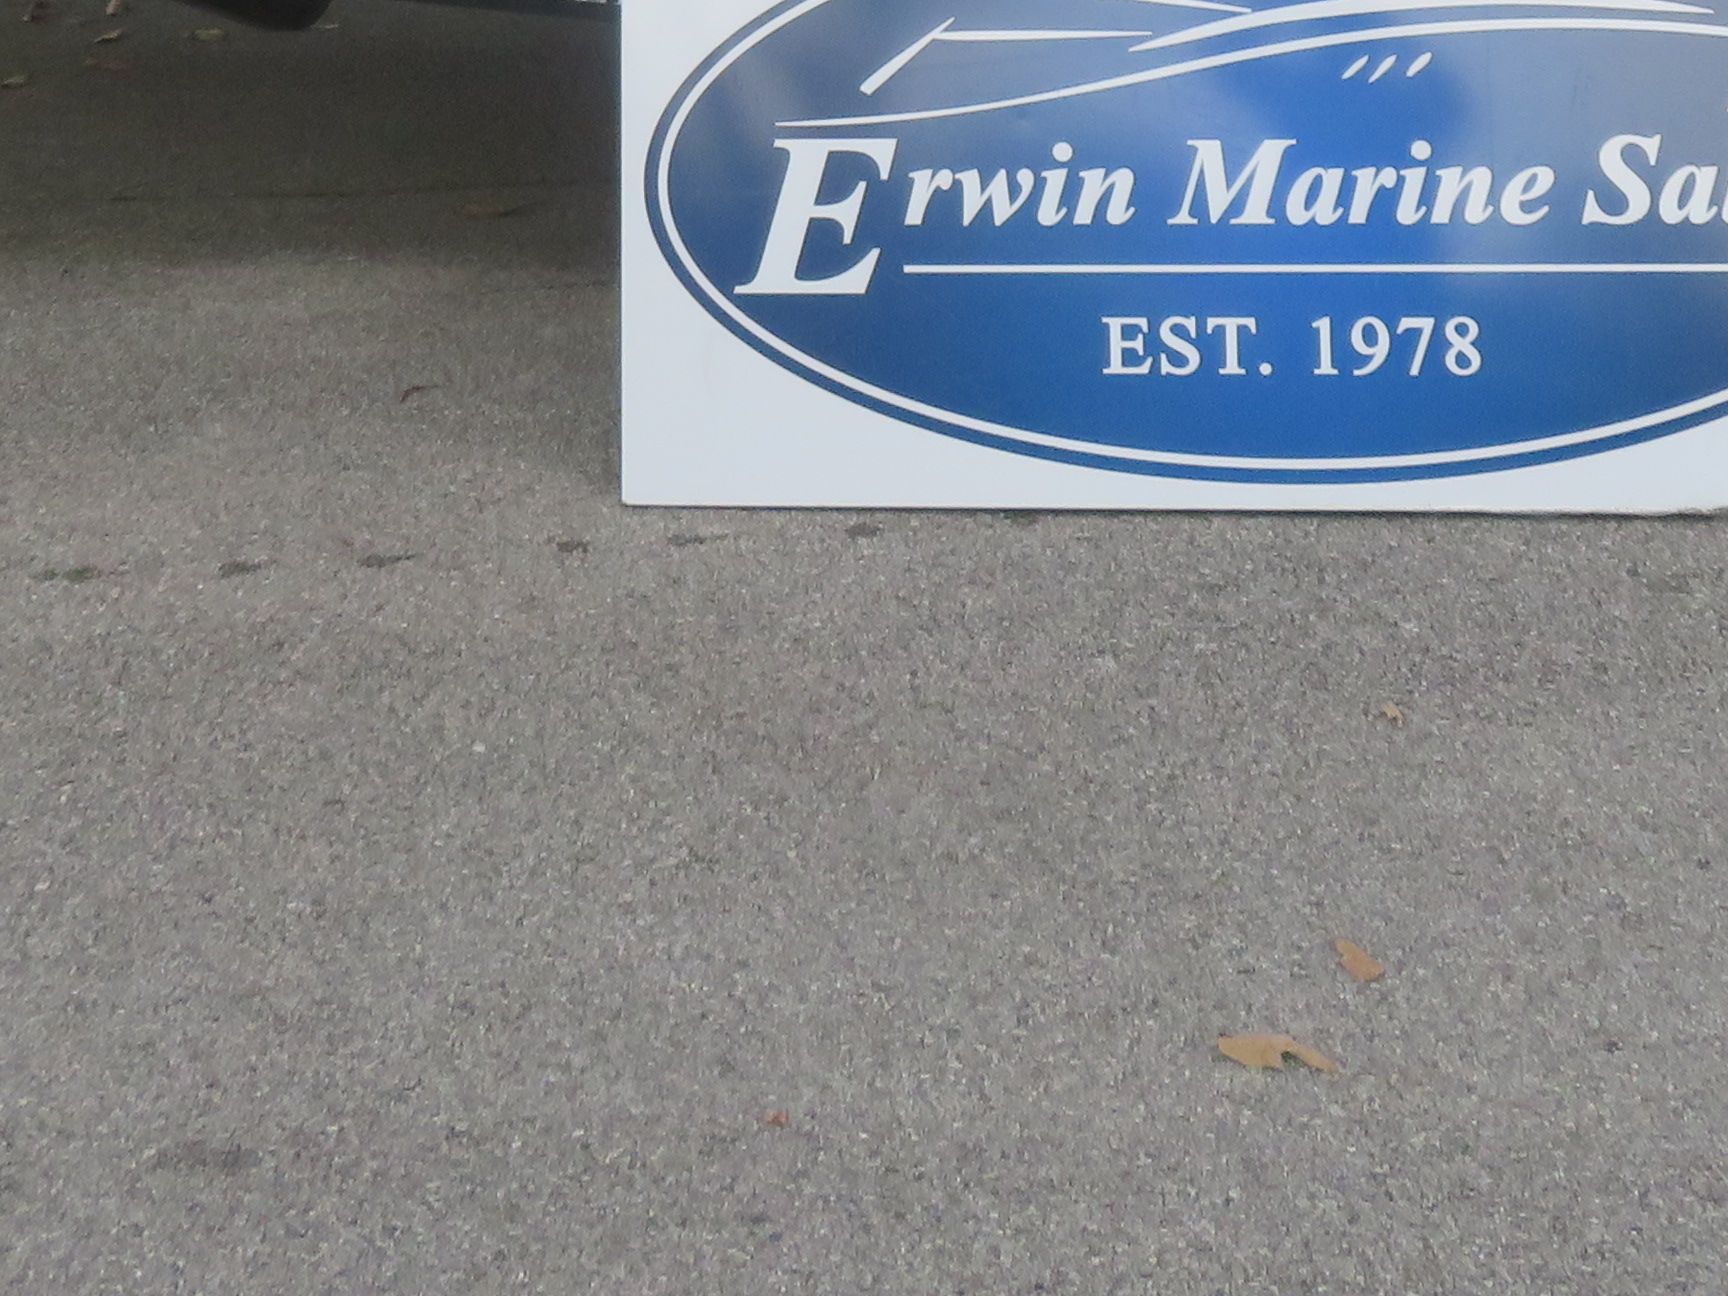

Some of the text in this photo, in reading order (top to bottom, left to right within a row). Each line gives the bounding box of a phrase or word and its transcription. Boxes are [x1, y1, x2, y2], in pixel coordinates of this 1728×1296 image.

[733, 136, 1136, 296] Erwin
[1167, 139, 1555, 226] Marine
[1102, 316, 1481, 375] EST. 1978
